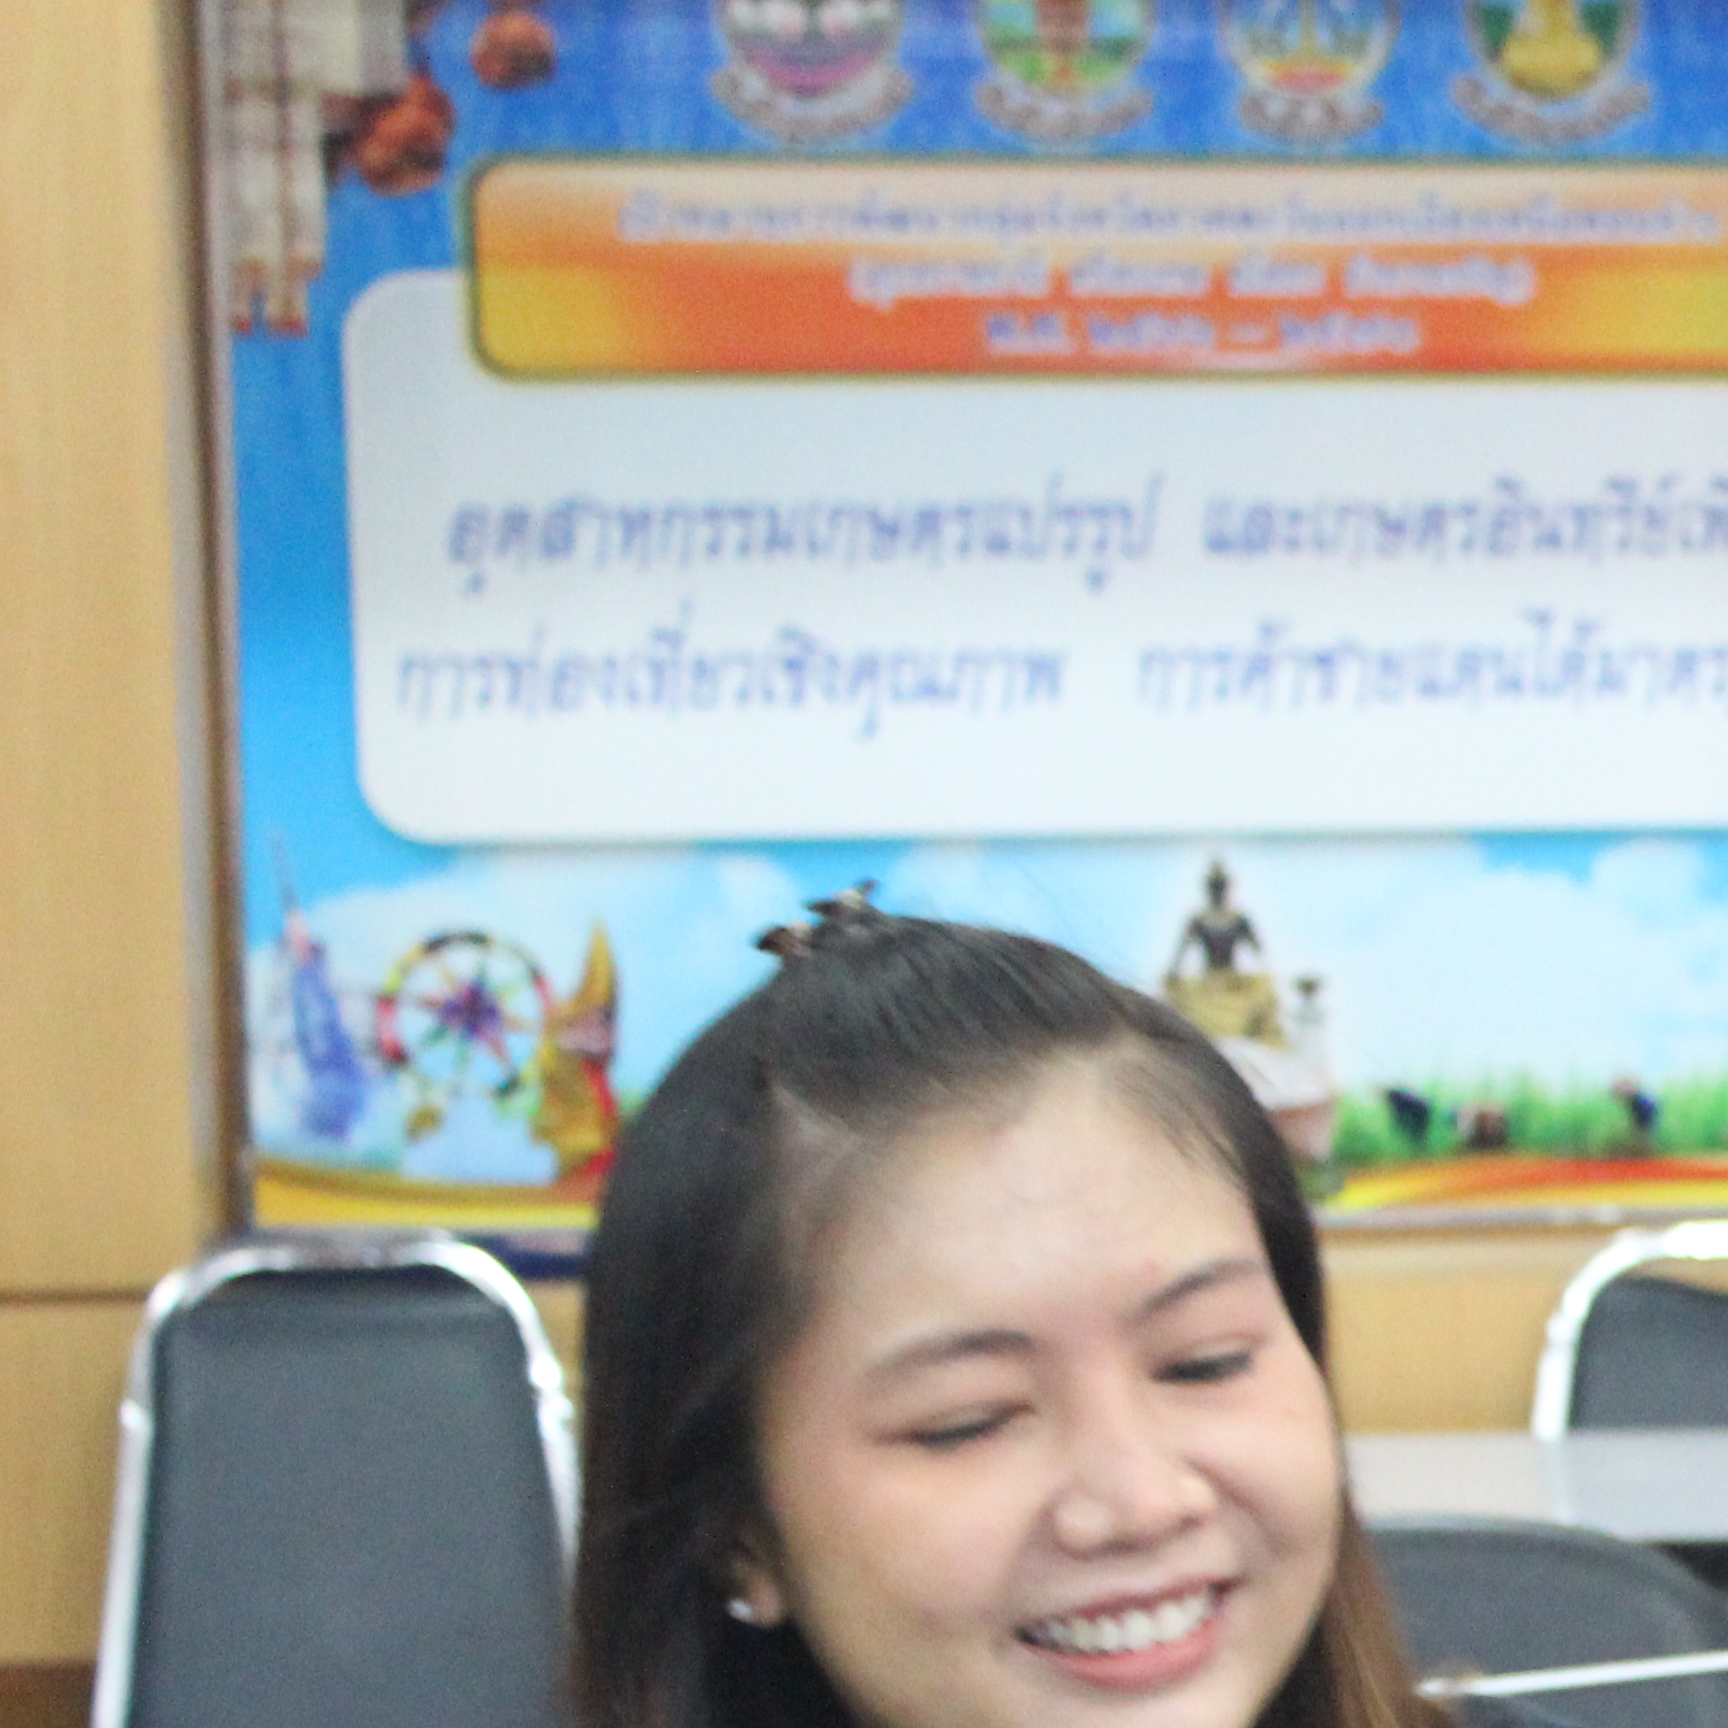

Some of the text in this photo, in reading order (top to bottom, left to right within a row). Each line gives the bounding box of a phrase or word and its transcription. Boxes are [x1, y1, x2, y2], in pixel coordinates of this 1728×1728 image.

[446, 468, 1164, 599] อุตสาหกรรมเกษตรแปรรูป
[399, 600, 1067, 741] การท่องเที่ยวเชิงคุณภาพ
